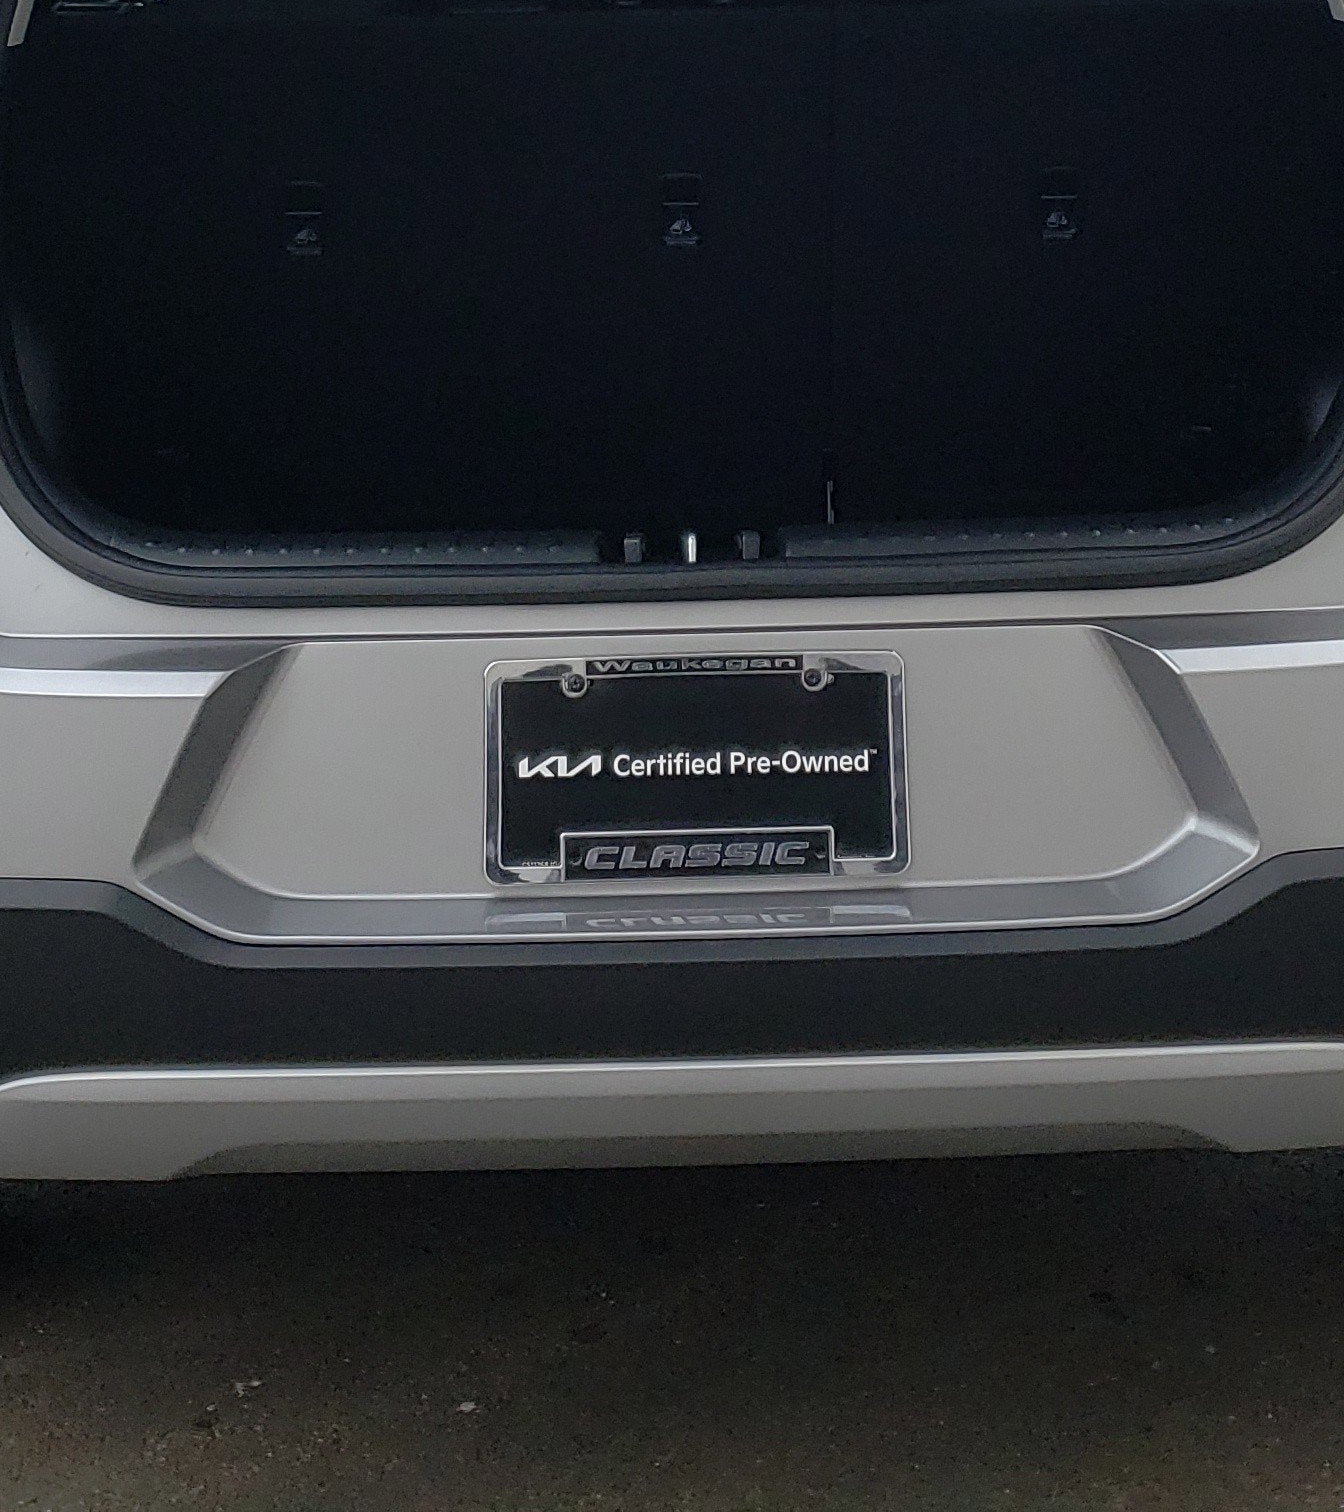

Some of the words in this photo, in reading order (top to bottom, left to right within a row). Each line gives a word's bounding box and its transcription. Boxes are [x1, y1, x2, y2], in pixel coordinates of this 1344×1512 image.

[593, 658, 797, 673] Waukegan
[518, 754, 602, 778] KIA
[613, 751, 722, 777] Certified
[584, 841, 810, 870] CLASSIC
